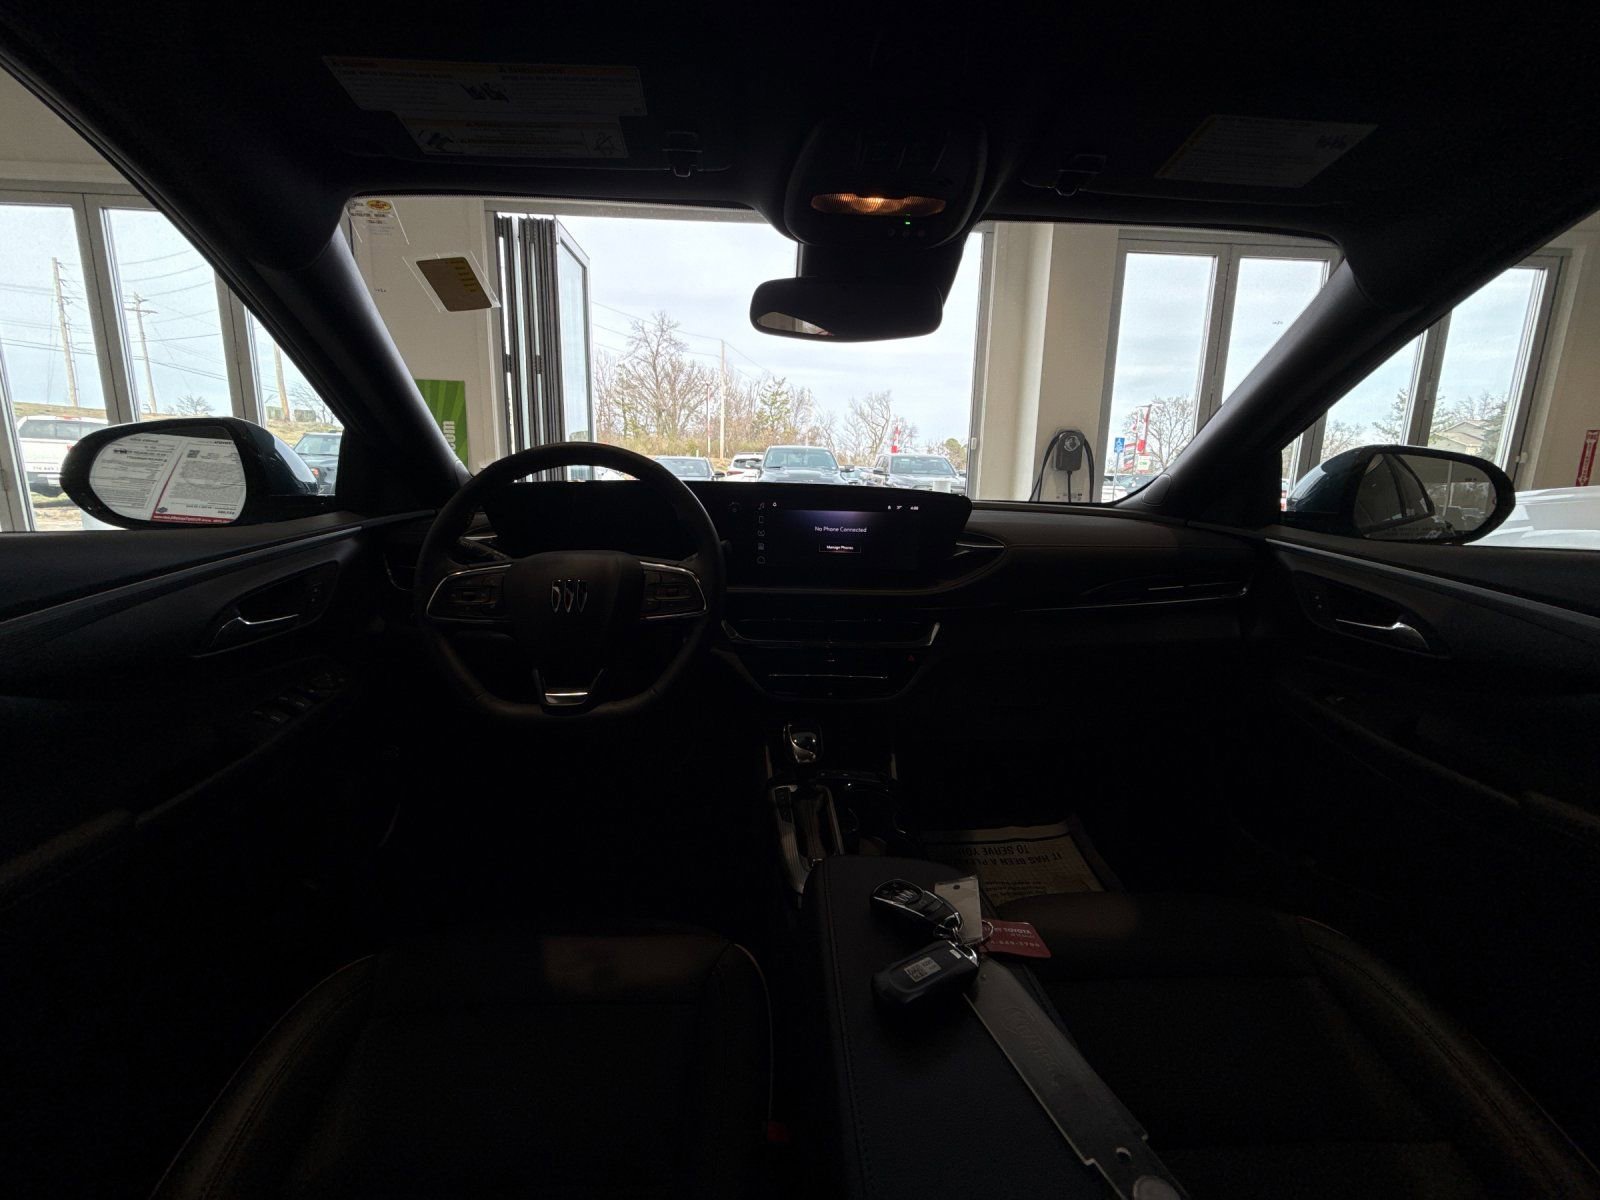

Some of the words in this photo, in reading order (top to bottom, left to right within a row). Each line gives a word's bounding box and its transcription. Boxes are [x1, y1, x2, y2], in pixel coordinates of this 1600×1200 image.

[981, 846, 1014, 856] SERVE
[999, 857, 1026, 866] BEEN
[1027, 855, 1050, 865] HAS
